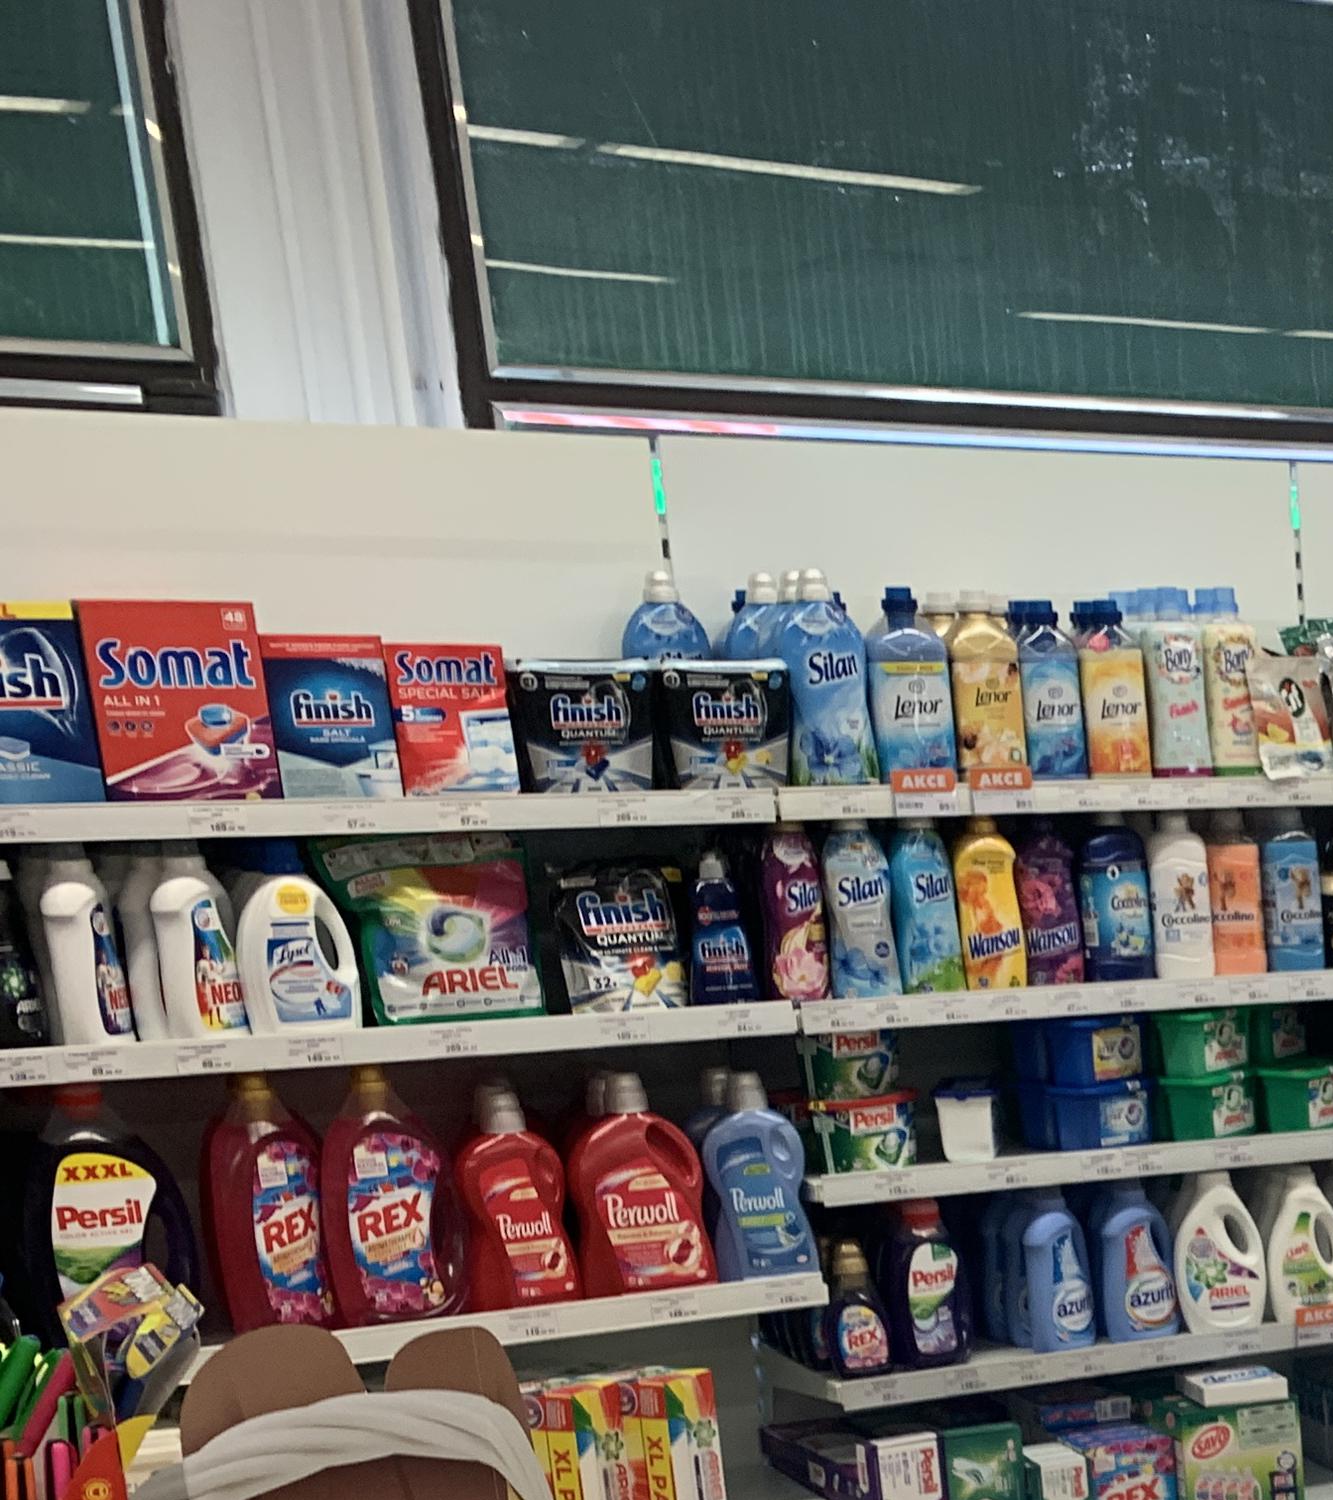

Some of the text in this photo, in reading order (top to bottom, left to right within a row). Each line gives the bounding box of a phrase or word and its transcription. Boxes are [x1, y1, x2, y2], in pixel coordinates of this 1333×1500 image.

[96, 639, 256, 690] Somat
[395, 647, 496, 686] Somat
[809, 650, 857, 685] Silan
[104, 695, 130, 707] ALL
[133, 695, 148, 707] IN
[291, 691, 375, 721] finish
[398, 687, 461, 700] SPECIAL
[895, 696, 942, 720] Lenor
[975, 685, 1010, 707] Lenor
[1036, 698, 1077, 718] Lenor
[1101, 697, 1141, 718] Lenor
[549, 694, 623, 726] finish
[692, 690, 768, 729] finish
[561, 728, 615, 740] QUANTUM
[901, 775, 947, 789] AKCE
[979, 772, 1024, 787] AKCE
[838, 876, 884, 905] Silan
[576, 891, 668, 937] finish
[1162, 913, 1210, 928] Coccolino
[701, 939, 745, 961] finish
[969, 928, 1020, 960] Wansou
[1026, 924, 1077, 955] Wansou
[423, 965, 517, 995] ARIEL
[853, 1110, 895, 1129] Persil
[63, 1163, 132, 1181] XXXL
[603, 1192, 679, 1225] Perwoll
[732, 1187, 785, 1212] Perwoll
[55, 1200, 142, 1230] Persil
[262, 1204, 317, 1251] REX
[357, 1197, 423, 1243] REX
[497, 1210, 552, 1239] Perwoll
[912, 1265, 955, 1287] Persil
[1130, 1285, 1175, 1308] azurit
[1209, 1284, 1249, 1300] ARIEL
[848, 1329, 879, 1349] REX
[648, 1436, 664, 1476] XL
[1191, 1426, 1230, 1459] SAVO
[552, 1449, 571, 1489] XL
[919, 1448, 939, 1495] Persil
